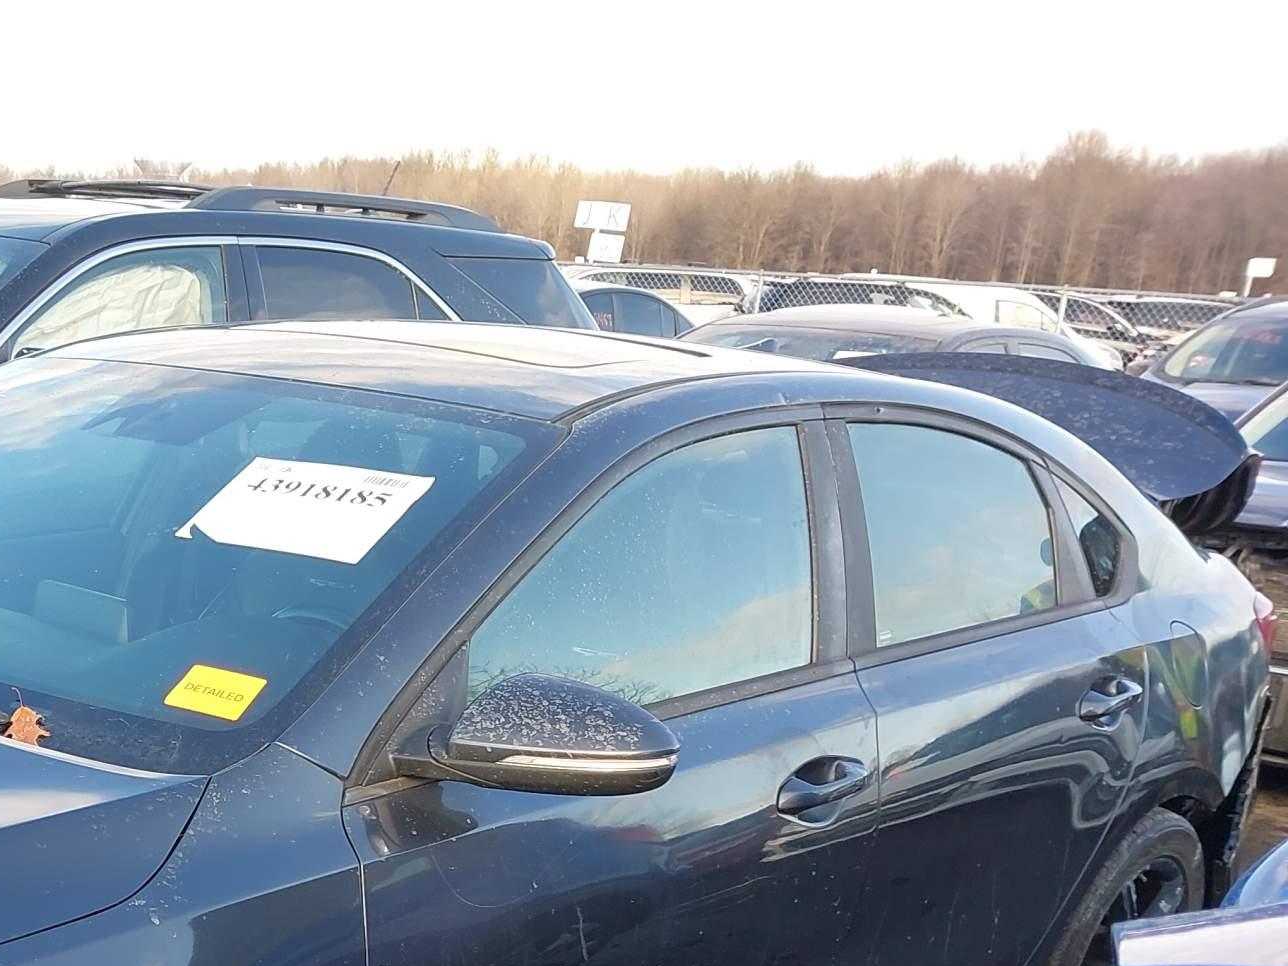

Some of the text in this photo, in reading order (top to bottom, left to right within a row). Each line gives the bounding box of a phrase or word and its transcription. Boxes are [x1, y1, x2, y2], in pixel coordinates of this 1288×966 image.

[607, 205, 623, 227] K
[247, 478, 393, 507] 43918185
[183, 682, 244, 702] DETAILED
